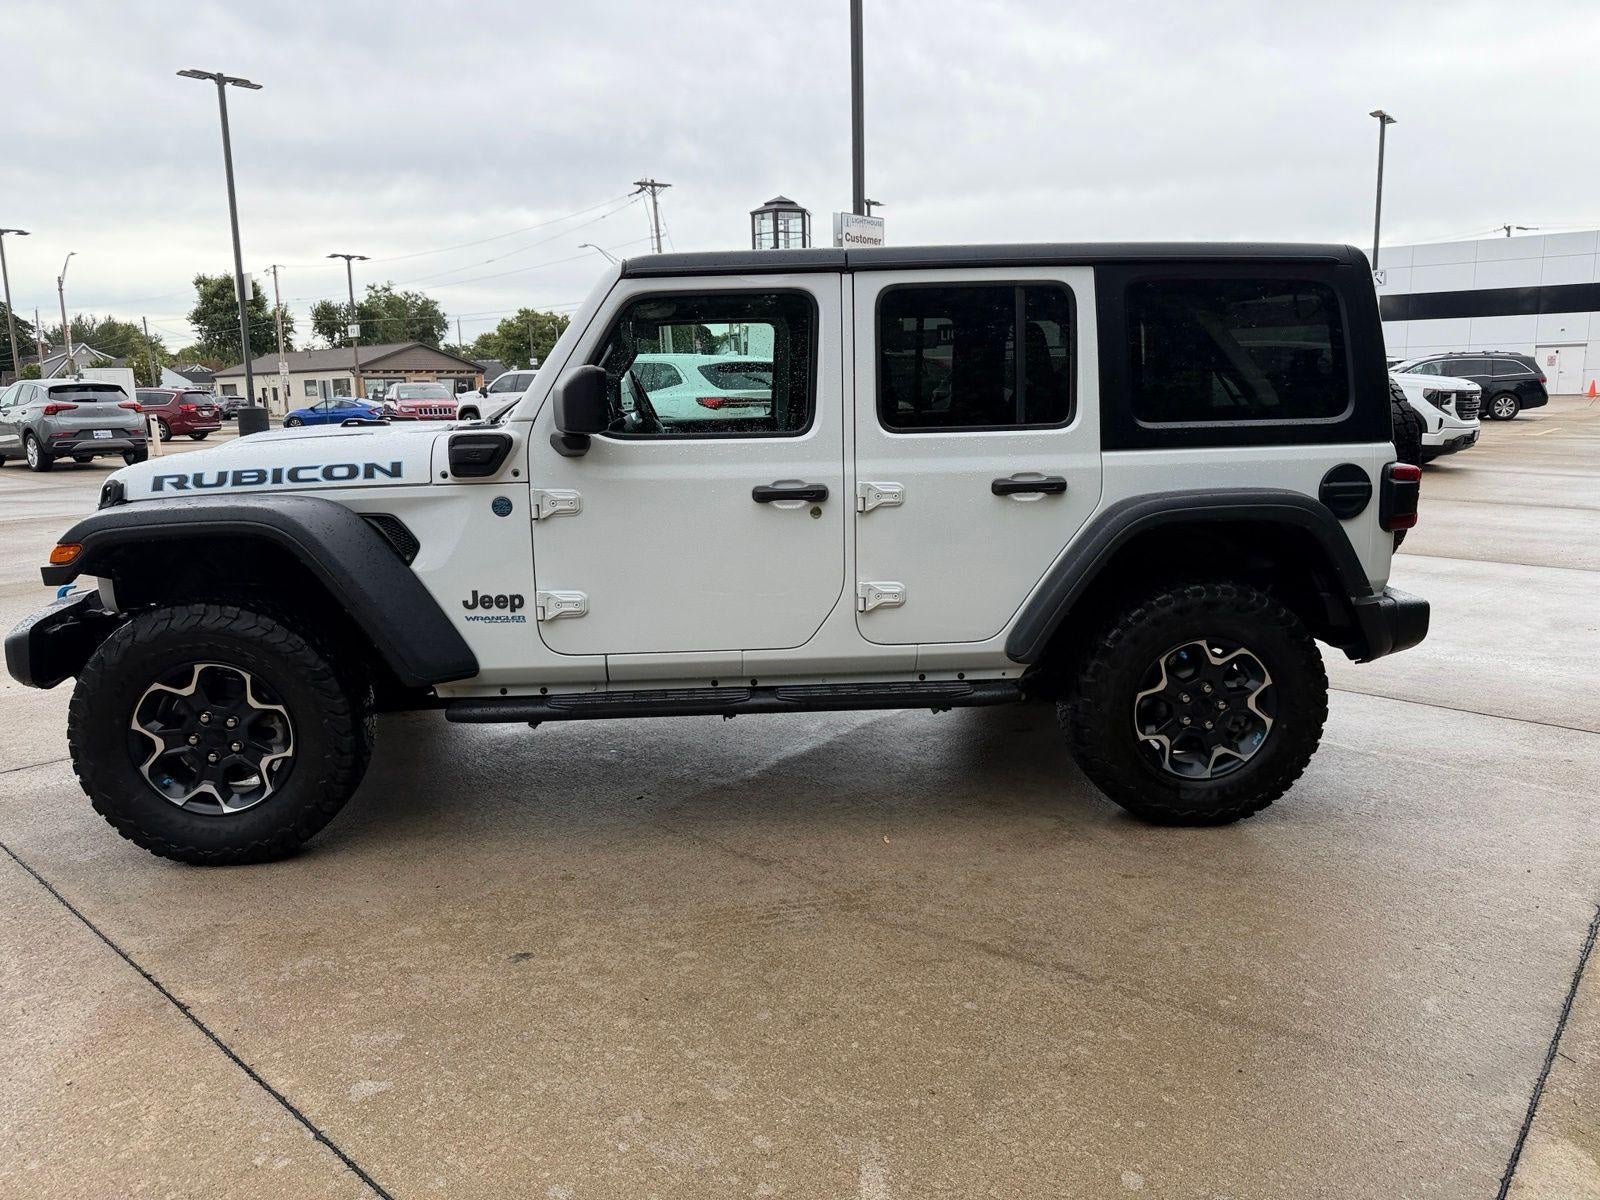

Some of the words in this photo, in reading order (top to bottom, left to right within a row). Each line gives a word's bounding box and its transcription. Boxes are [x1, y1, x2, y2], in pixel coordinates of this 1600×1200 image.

[844, 231, 882, 245] Customer
[151, 460, 403, 492] RUBICON
[462, 590, 524, 613] Jeep
